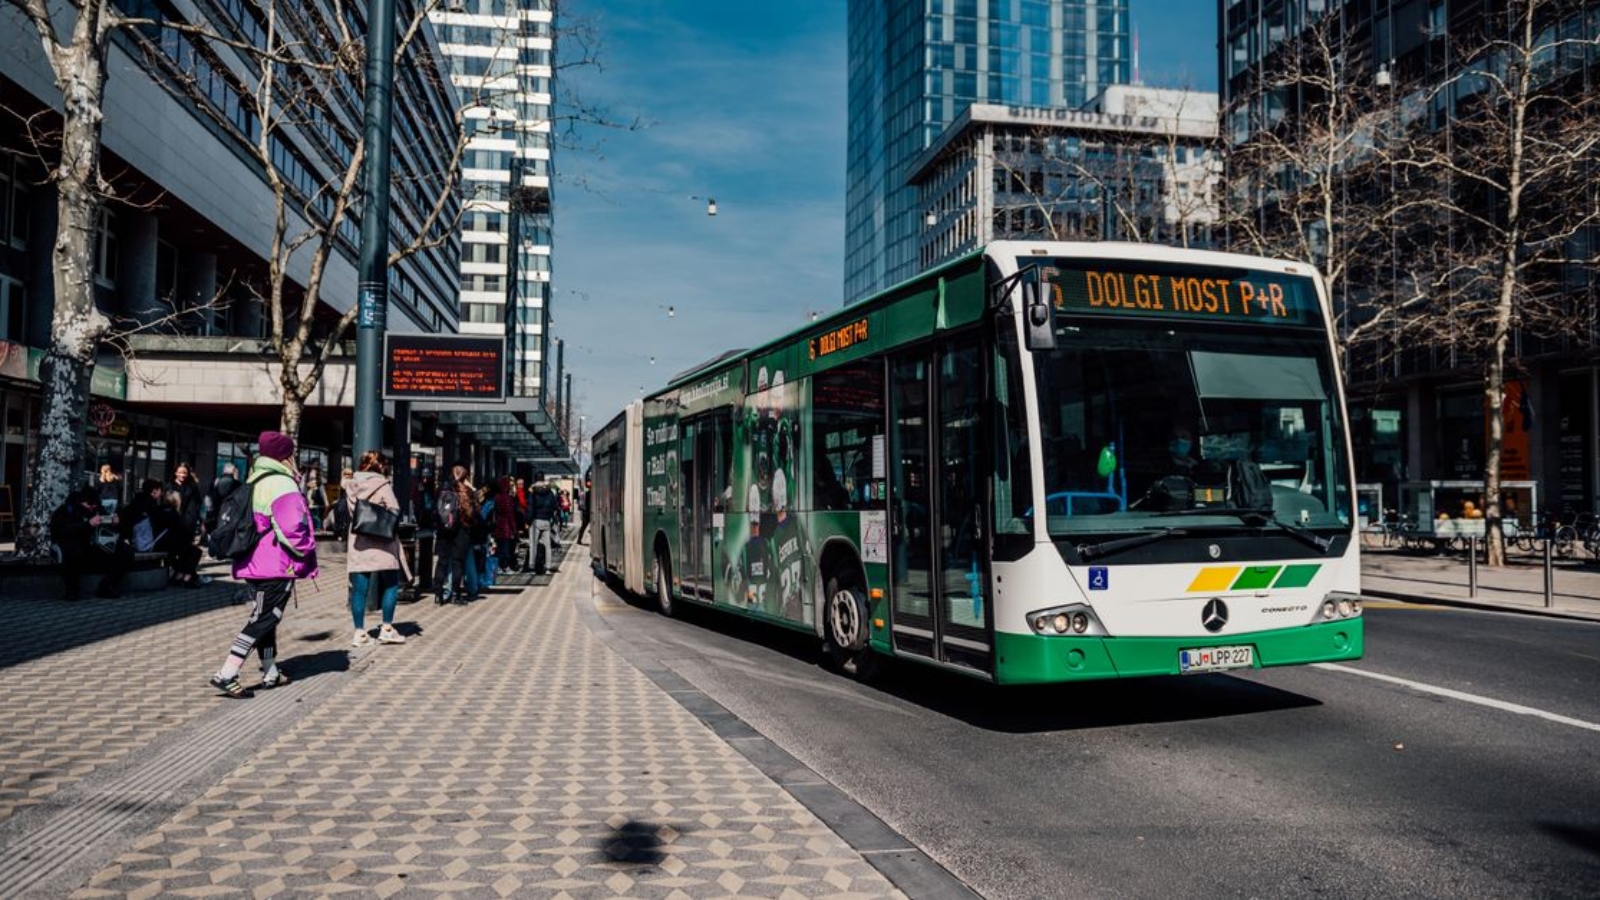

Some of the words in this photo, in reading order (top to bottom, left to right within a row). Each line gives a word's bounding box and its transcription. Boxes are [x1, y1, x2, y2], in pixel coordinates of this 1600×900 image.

[1086, 270, 1163, 310] DOLGI
[1170, 277, 1230, 313] MOST
[1239, 281, 1287, 317] P+R
[837, 324, 853, 350] MOST
[854, 319, 868, 343] P+R
[1260, 605, 1308, 614] CONECTO
[1189, 651, 1202, 667] LJ
[1210, 650, 1230, 665] LPP
[1232, 648, 1250, 664] 227
